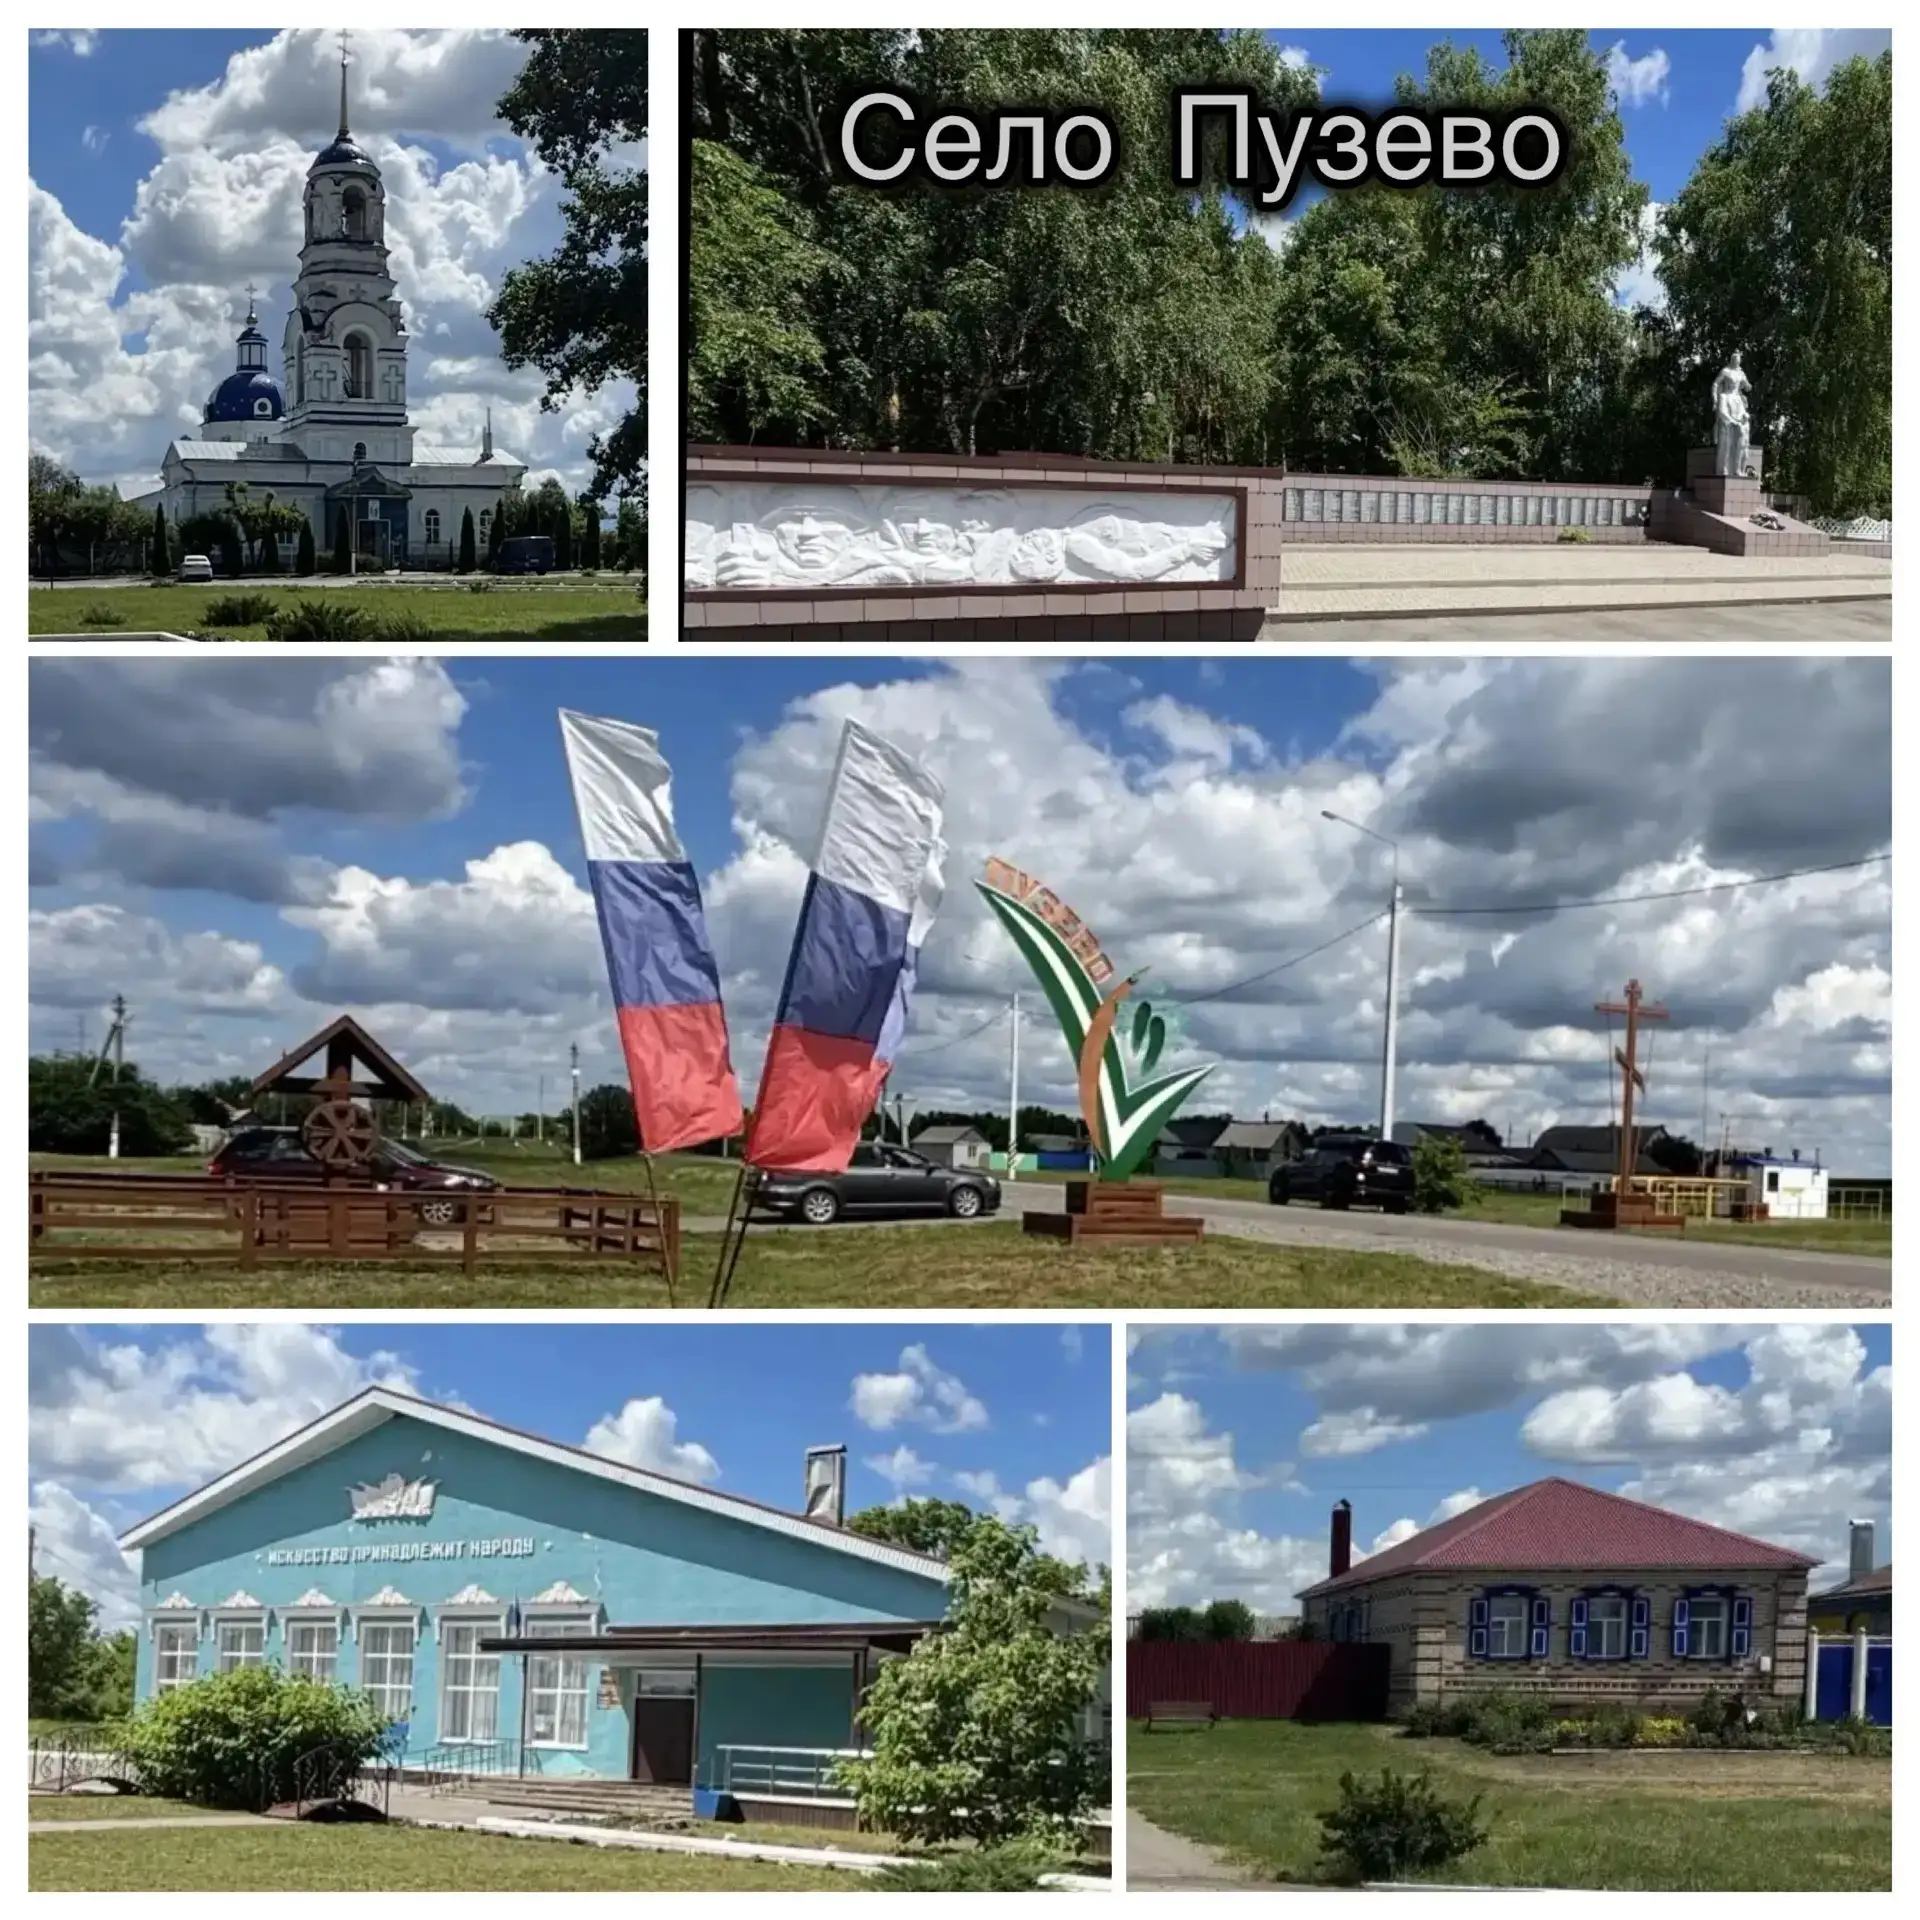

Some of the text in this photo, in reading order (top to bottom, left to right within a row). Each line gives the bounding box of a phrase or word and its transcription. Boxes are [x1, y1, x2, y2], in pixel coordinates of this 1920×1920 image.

[268, 1536, 535, 1565] ИСКУССТВО ПРИНАДЛЕЖИТ НАРОДУ
